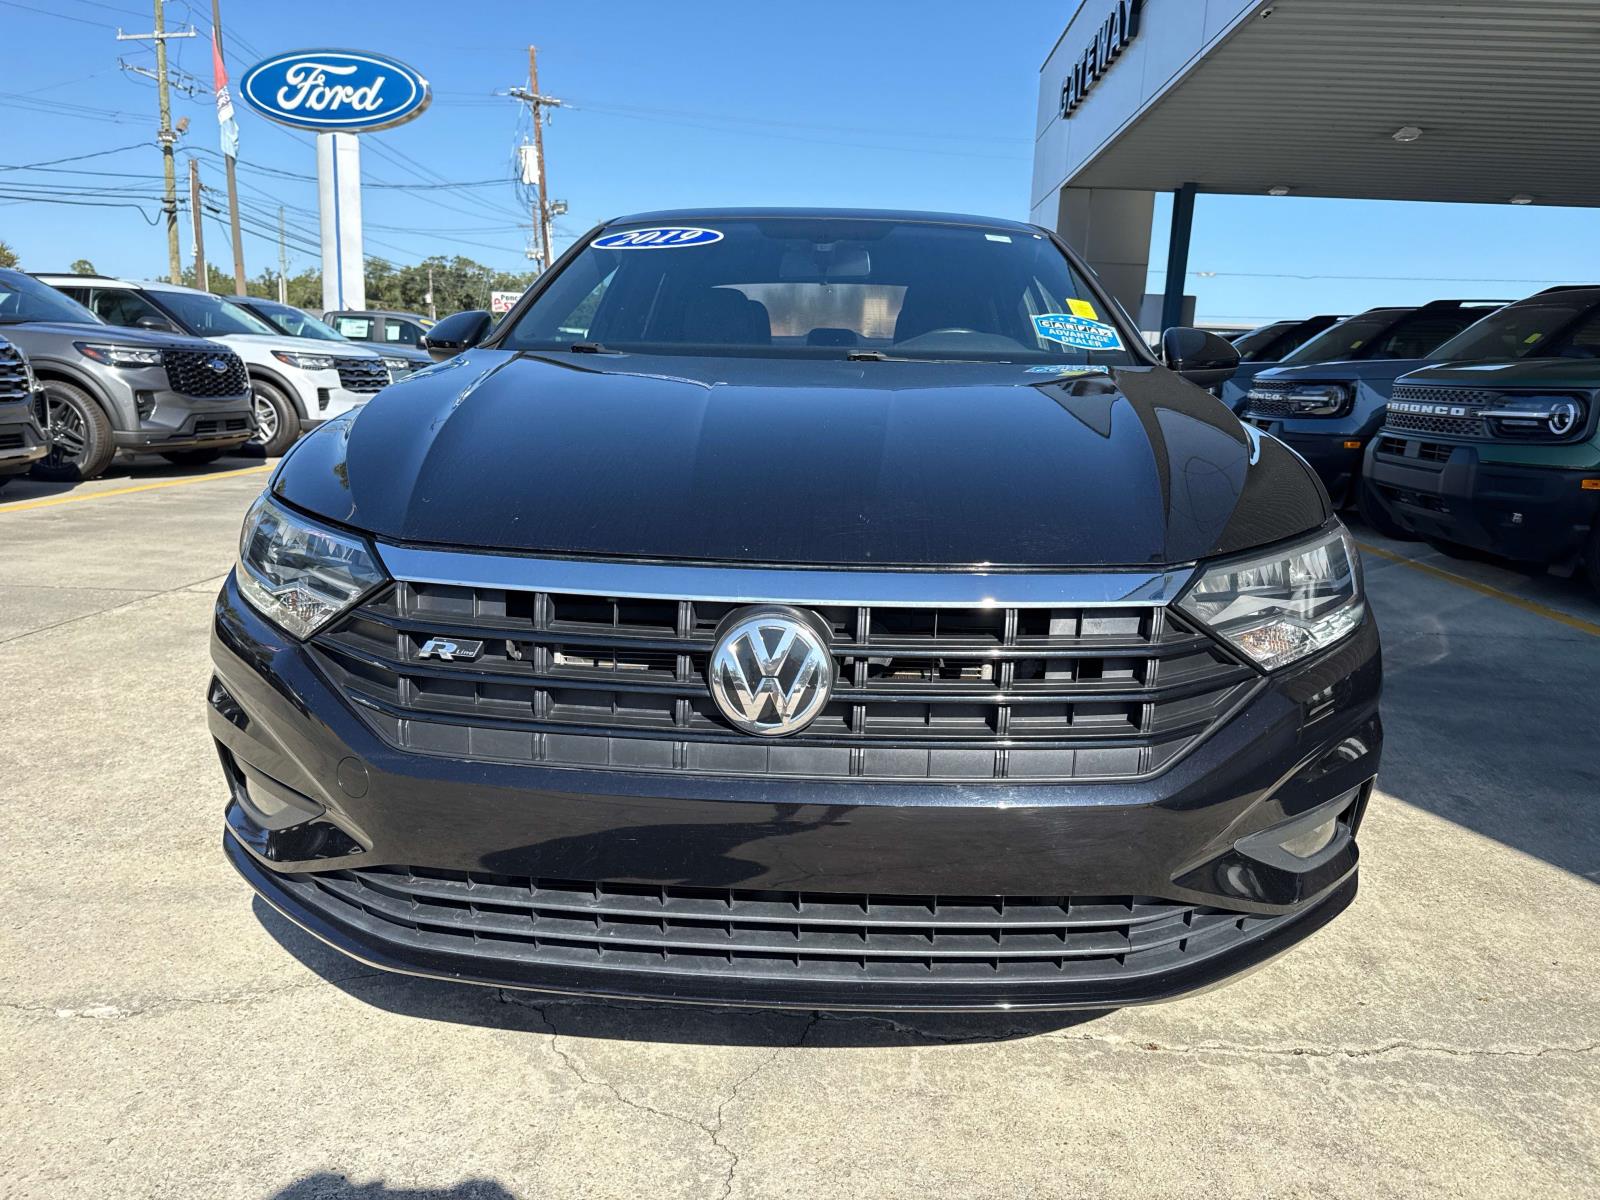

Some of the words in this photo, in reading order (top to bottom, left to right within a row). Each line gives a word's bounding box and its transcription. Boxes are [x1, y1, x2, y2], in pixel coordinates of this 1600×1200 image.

[1060, 0, 1143, 120] GATEWAY
[276, 62, 386, 111] Ford
[607, 230, 703, 246] 2019
[1040, 321, 1113, 338] CARFAX
[1049, 329, 1110, 344] ADVANTAGE
[1061, 336, 1102, 348] DEALER
[1391, 402, 1466, 416] BRONCO
[713, 617, 829, 733] VW
